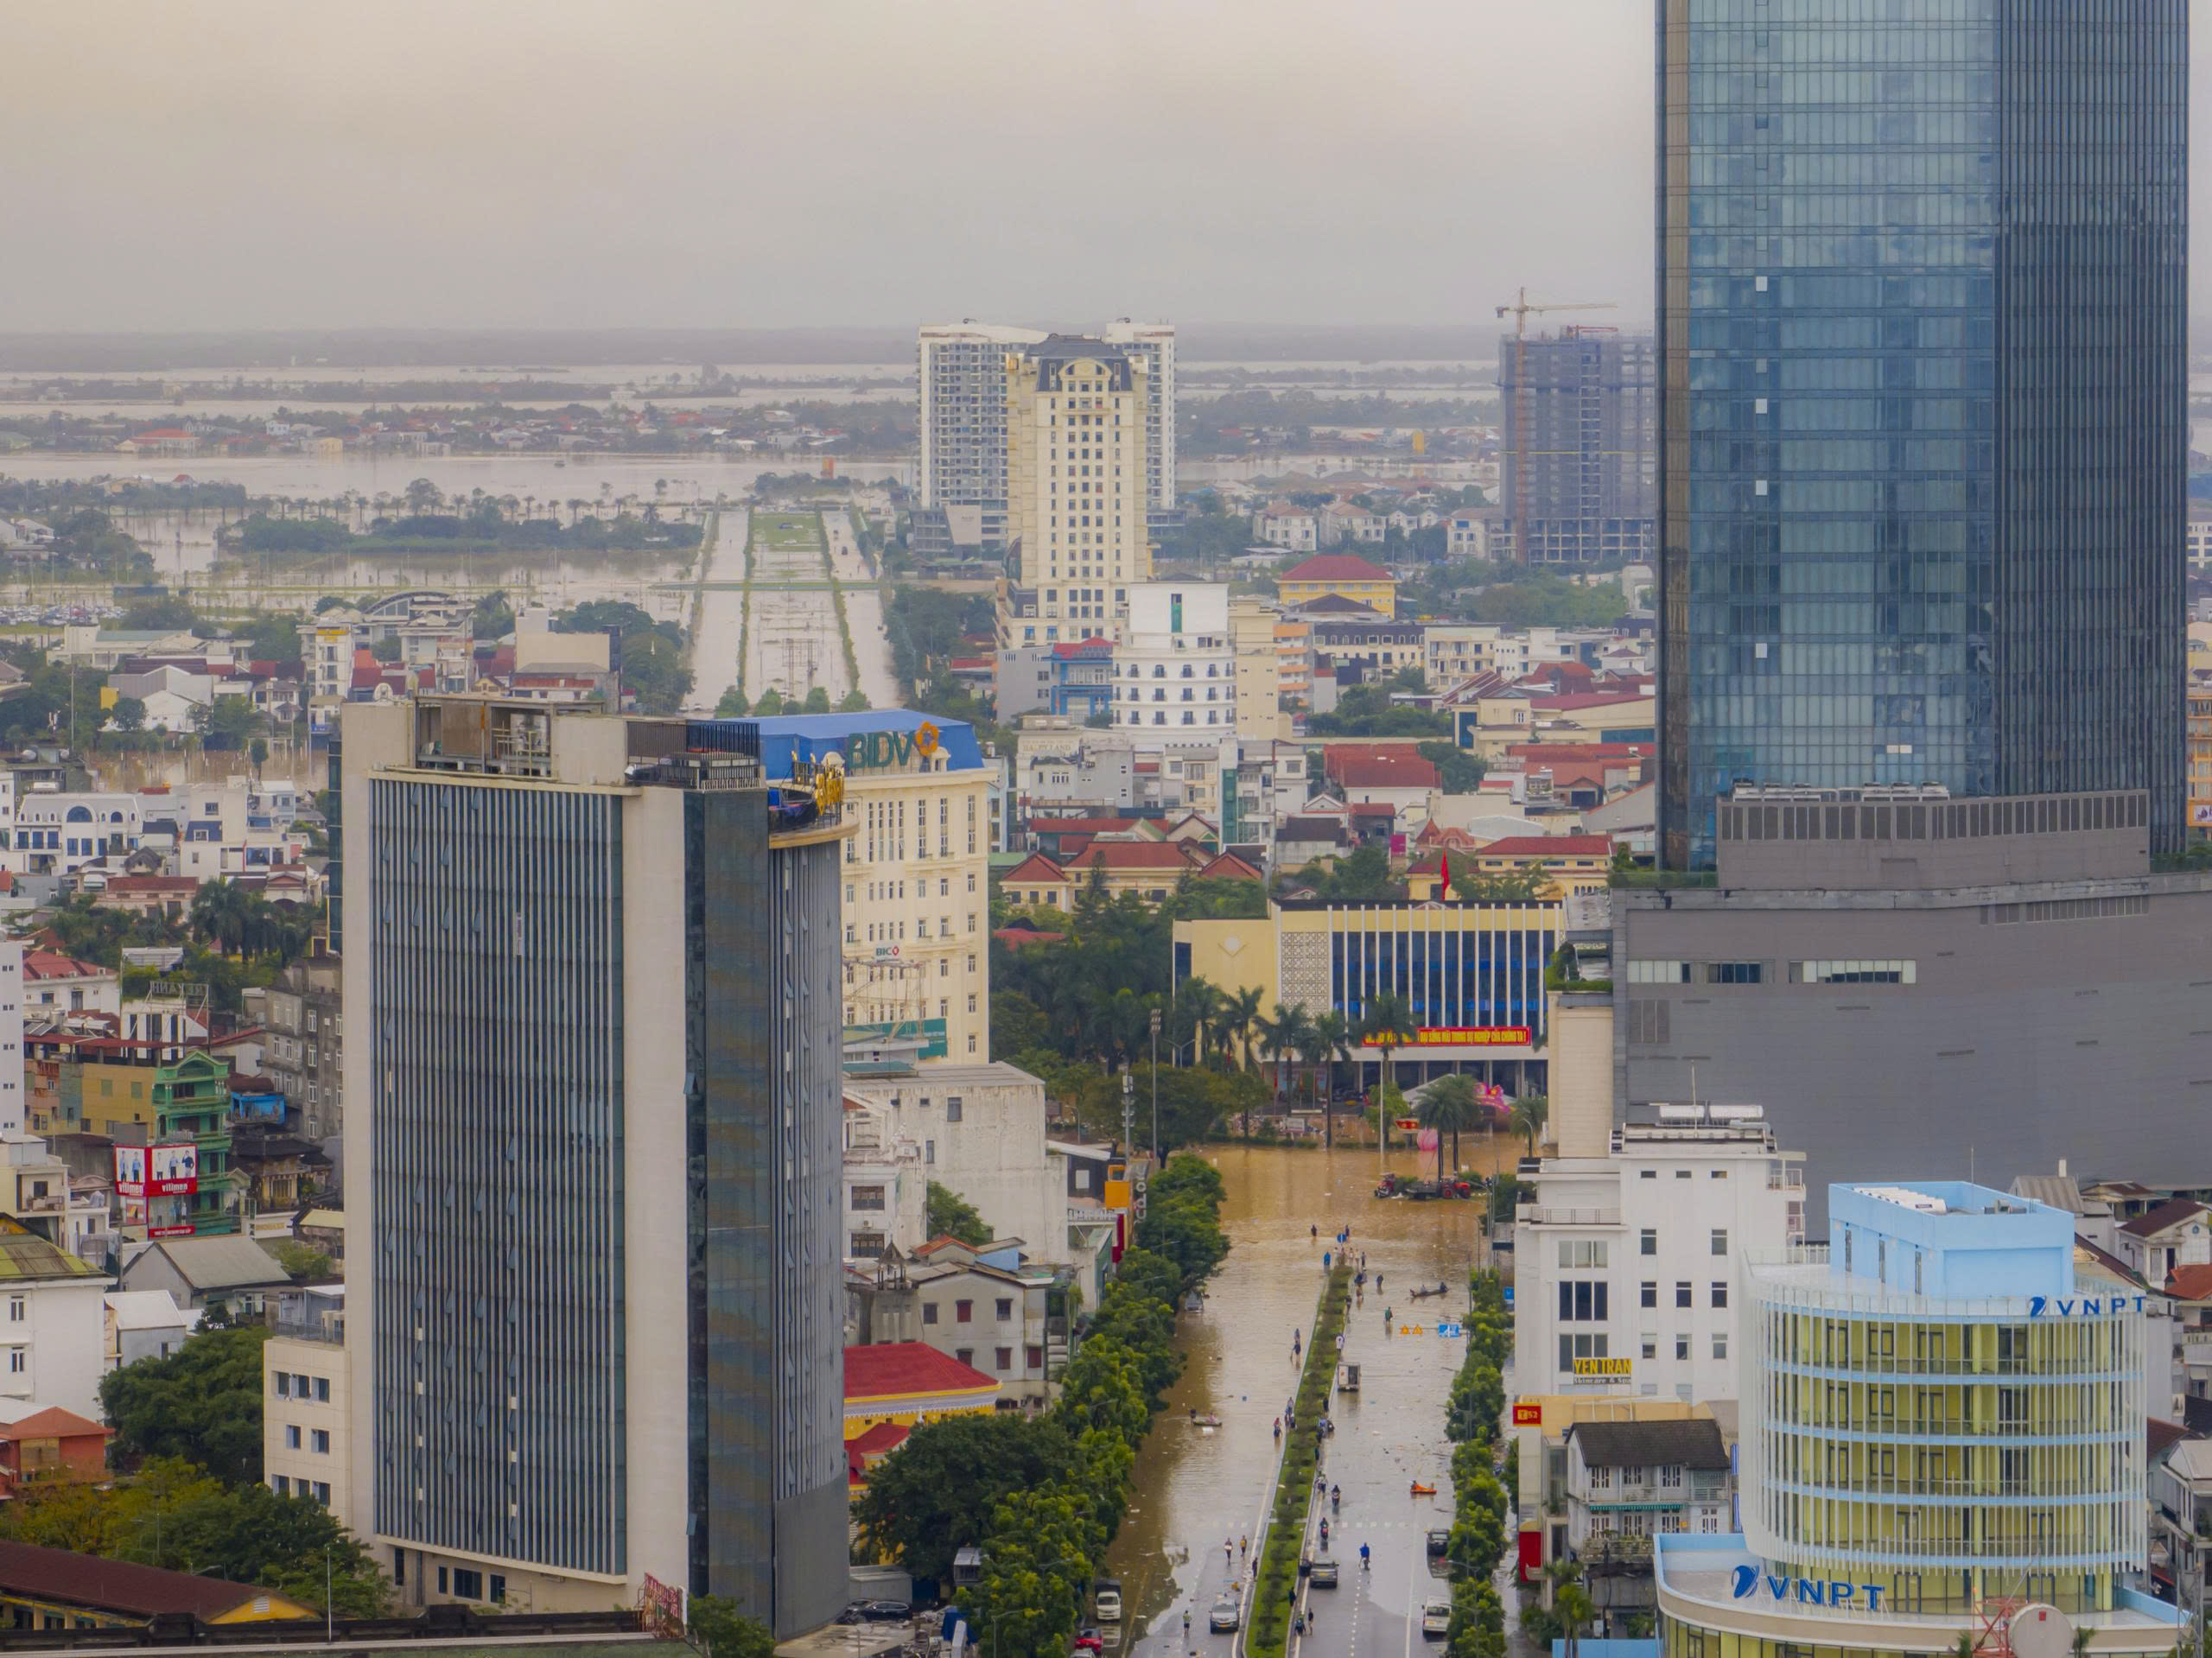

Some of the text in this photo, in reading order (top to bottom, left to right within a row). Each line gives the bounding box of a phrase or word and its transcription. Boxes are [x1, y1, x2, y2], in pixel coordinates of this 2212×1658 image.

[849, 730, 916, 769] BIDV
[2056, 1296, 2146, 1316] VNPT
[1767, 1575, 1885, 1611] VNPT
